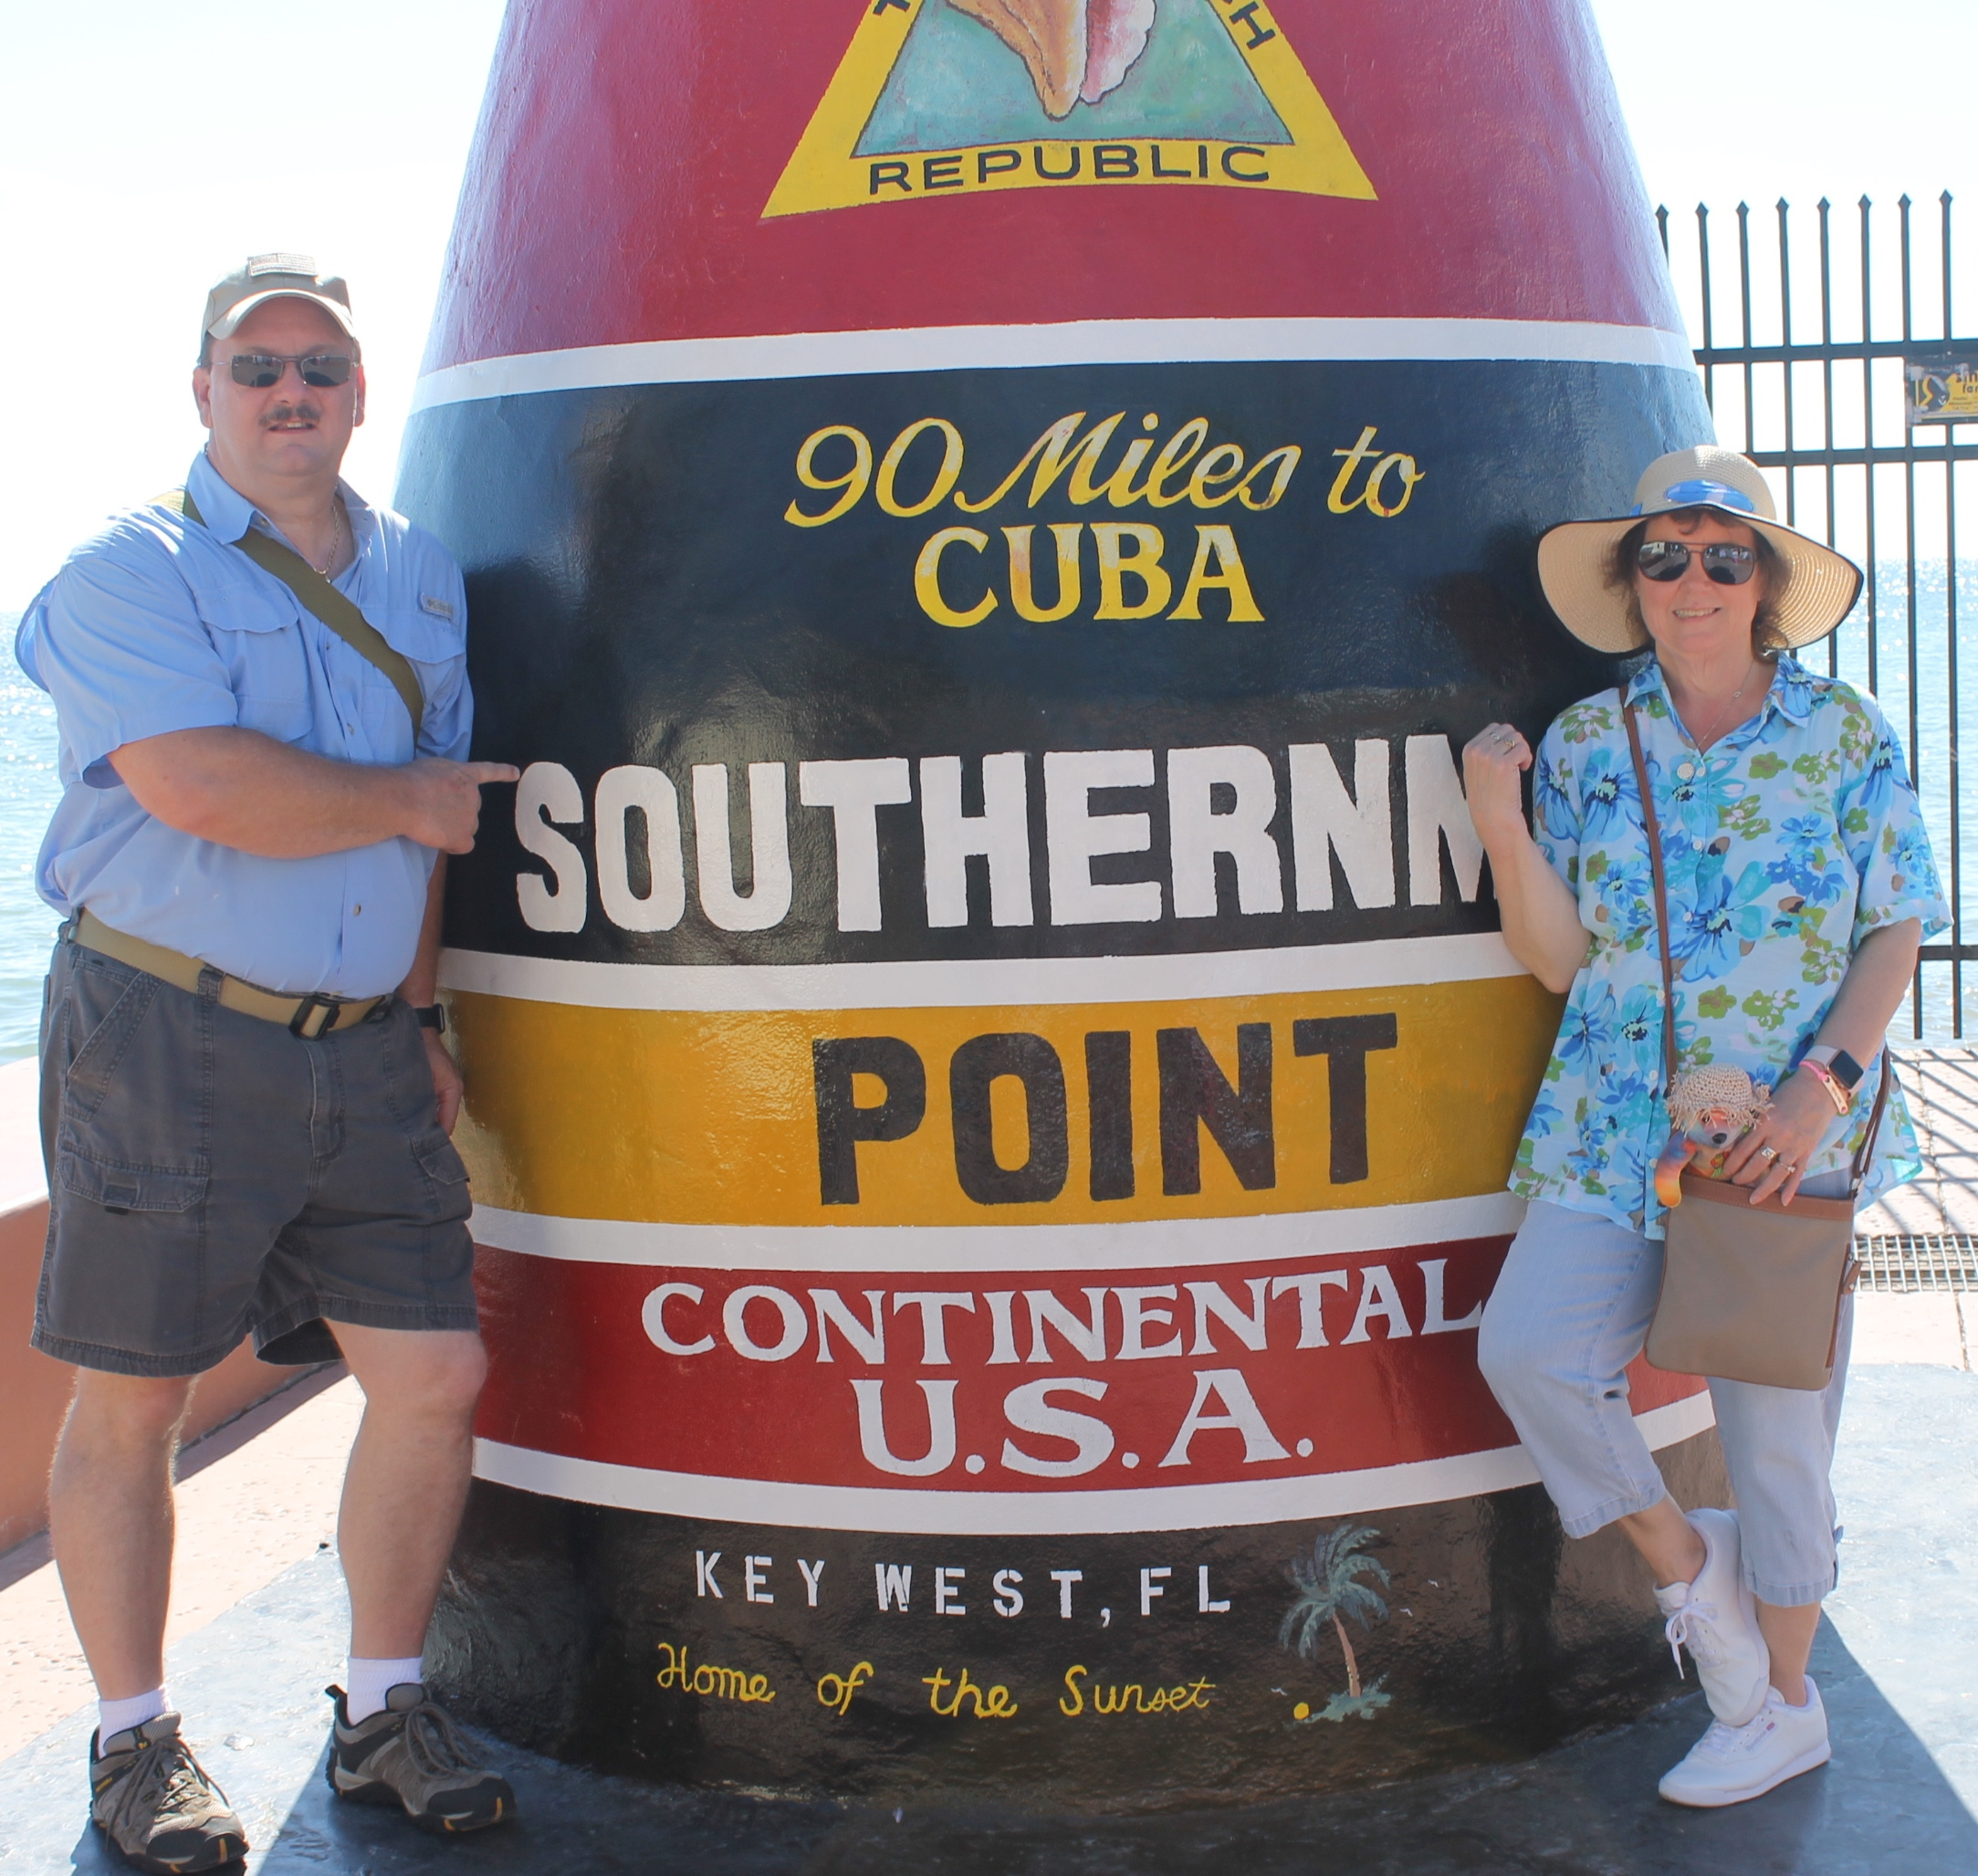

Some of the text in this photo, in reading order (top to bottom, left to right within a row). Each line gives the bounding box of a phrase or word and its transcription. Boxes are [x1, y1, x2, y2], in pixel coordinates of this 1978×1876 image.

[869, 144, 1270, 194] REPUBLIC
[784, 411, 1426, 528] 90 Miles to
[915, 522, 1266, 627] CUBA
[811, 1012, 1398, 1206] POINT
[641, 1259, 1482, 1366] CONTINENTAL
[849, 1368, 1314, 1477] U.S.A.
[695, 1549, 825, 1608] KEY
[1139, 1566, 1231, 1617] FL
[656, 1642, 1217, 1718] Home of the Sunset
